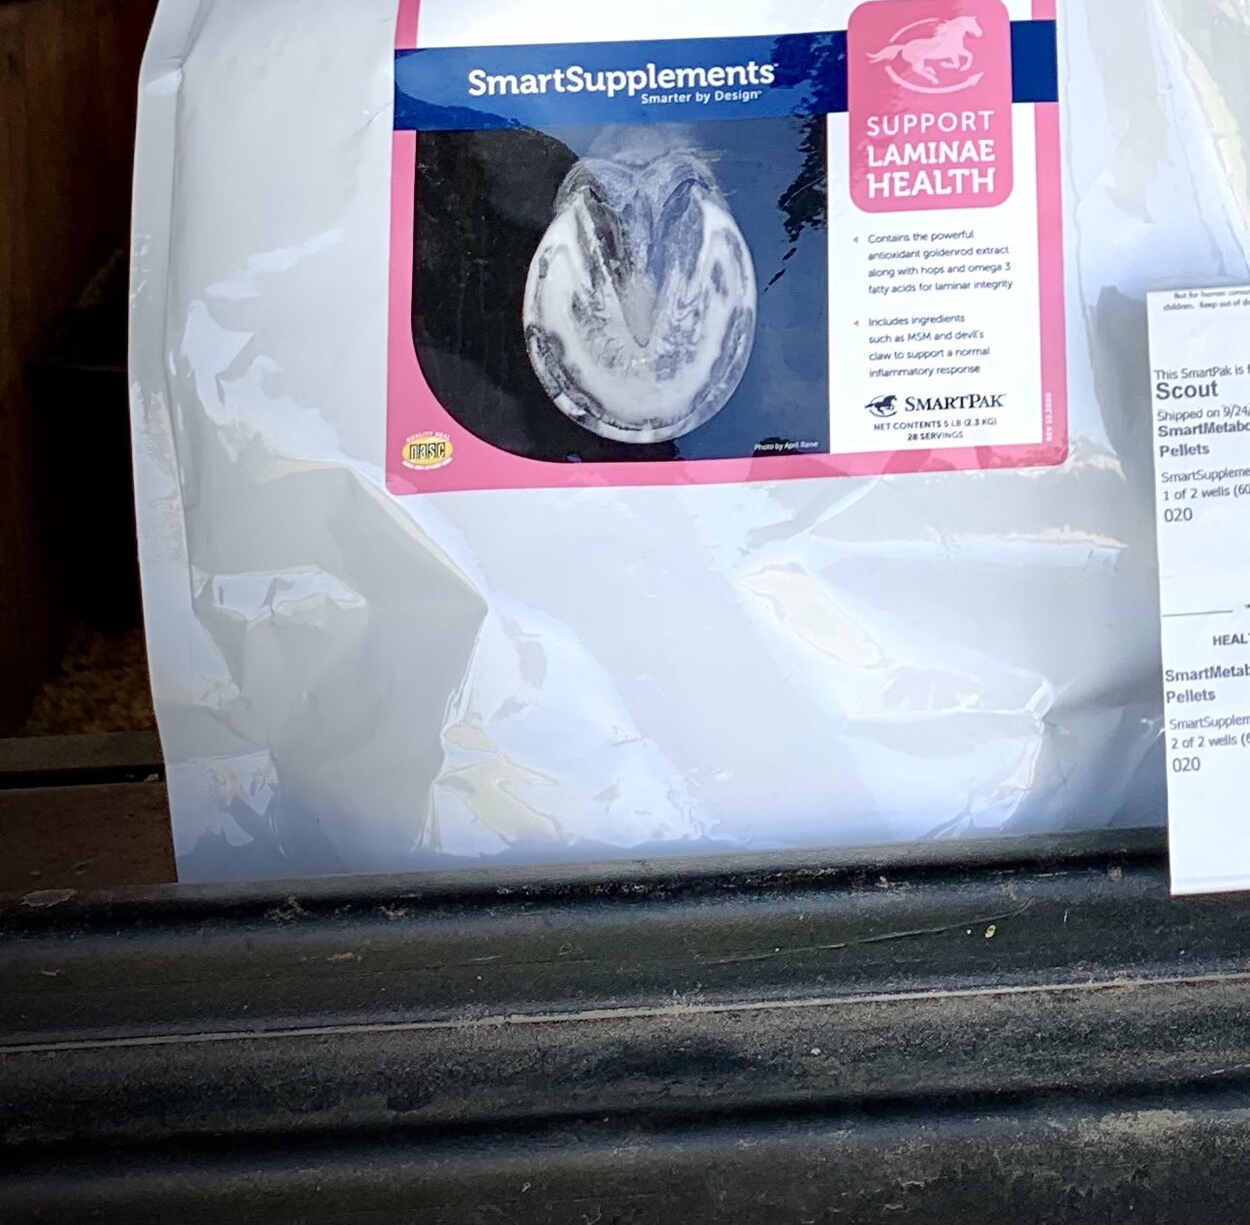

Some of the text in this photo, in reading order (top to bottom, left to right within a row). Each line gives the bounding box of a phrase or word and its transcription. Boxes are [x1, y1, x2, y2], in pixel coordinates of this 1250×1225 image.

[468, 61, 776, 98] SmartSupplements
[641, 89, 757, 105] Smarter by Design
[867, 110, 995, 137] SUPPORT
[867, 139, 996, 167] LAMINAE
[866, 167, 995, 198] HEALTH
[868, 230, 974, 244] Contains the powerful
[868, 246, 1009, 261] antioxidant goldenrod extract
[868, 261, 1011, 278] along with hops and omega 3
[868, 280, 1013, 296] fatty acids for laminar integrity
[868, 314, 965, 327] Includes ingredients
[869, 334, 892, 344] such
[894, 335, 905, 343] as
[907, 332, 932, 341] MSM
[934, 331, 952, 340] and
[869, 352, 891, 361] claw
[894, 351, 904, 360] to
[906, 350, 944, 360] support
[955, 346, 990, 356] normal
[869, 365, 981, 378] inflammatory response
[1154, 369, 1178, 380] This
[1180, 365, 1232, 379] SmartPak
[1235, 364, 1244, 375] is
[1156, 380, 1219, 400] Scout
[1157, 408, 1203, 423] Shipped
[1206, 409, 1220, 418] on
[873, 423, 891, 431] NET
[893, 420, 941, 430] CONTENTS
[907, 431, 964, 441] 28 SERVINGS
[1159, 443, 1210, 458] Pellets
[1163, 490, 1169, 501] 1
[1174, 489, 1186, 500] of
[1190, 488, 1198, 499] 2
[1201, 486, 1230, 498] wells
[1234, 483, 1250, 498] (60
[1164, 507, 1193, 522] 020
[1166, 689, 1216, 704] Pellets
[1171, 738, 1179, 749] 2
[1182, 736, 1195, 749] of
[1197, 736, 1205, 748] 2
[1208, 734, 1238, 746] wells
[1172, 756, 1201, 773] 020
